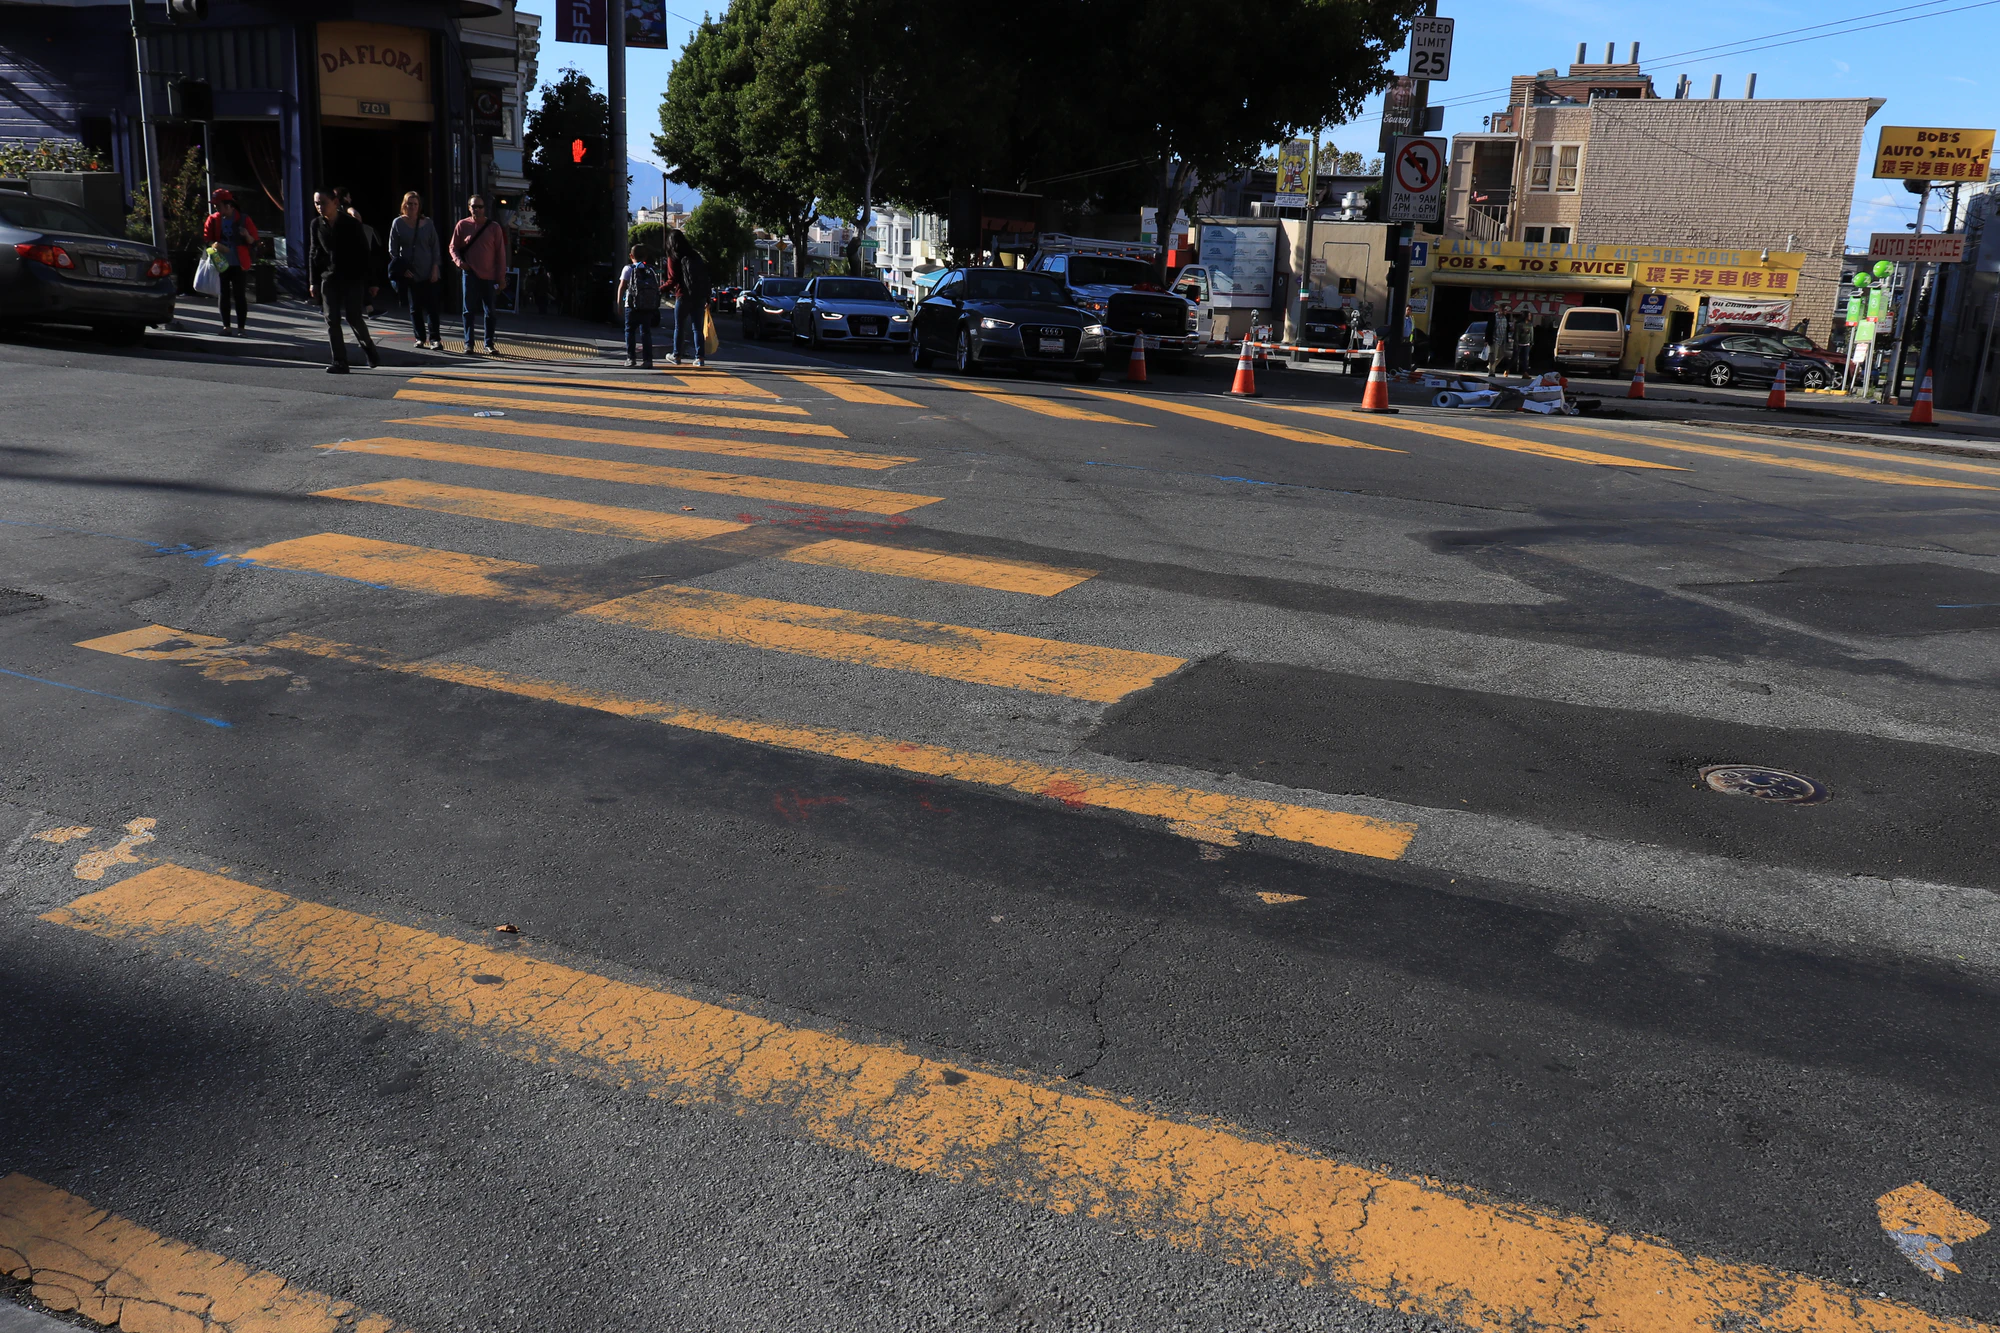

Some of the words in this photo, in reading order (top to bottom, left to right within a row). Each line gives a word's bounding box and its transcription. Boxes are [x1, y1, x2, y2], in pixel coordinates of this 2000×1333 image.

[573, 0, 591, 43] SFJ
[1415, 22, 1451, 34] SPEED
[1417, 37, 1446, 48] LIMIT
[320, 47, 355, 73] DA
[355, 45, 423, 82] FLORA
[1413, 51, 1445, 74] 25
[362, 103, 386, 114] 701
[1383, 113, 1411, 128] Courag
[1917, 131, 1961, 143] BOB'S
[1882, 145, 1924, 157] AUTO
[1880, 160, 1985, 178] 環宇汽車修理
[1394, 193, 1411, 203] 7AM
[1419, 194, 1437, 204] 9AM
[1392, 203, 1411, 212] 4PM
[1418, 204, 1437, 214] 6PM
[1451, 240, 1501, 255] AUTO
[1523, 243, 1597, 259] REPAIR
[1871, 239, 1905, 255] AUTO
[1907, 239, 1962, 257] SERVICE
[1645, 267, 1789, 289] 環宇汽車修理
[1497, 290, 1565, 302] TIRE
[1709, 309, 1762, 321] Special
